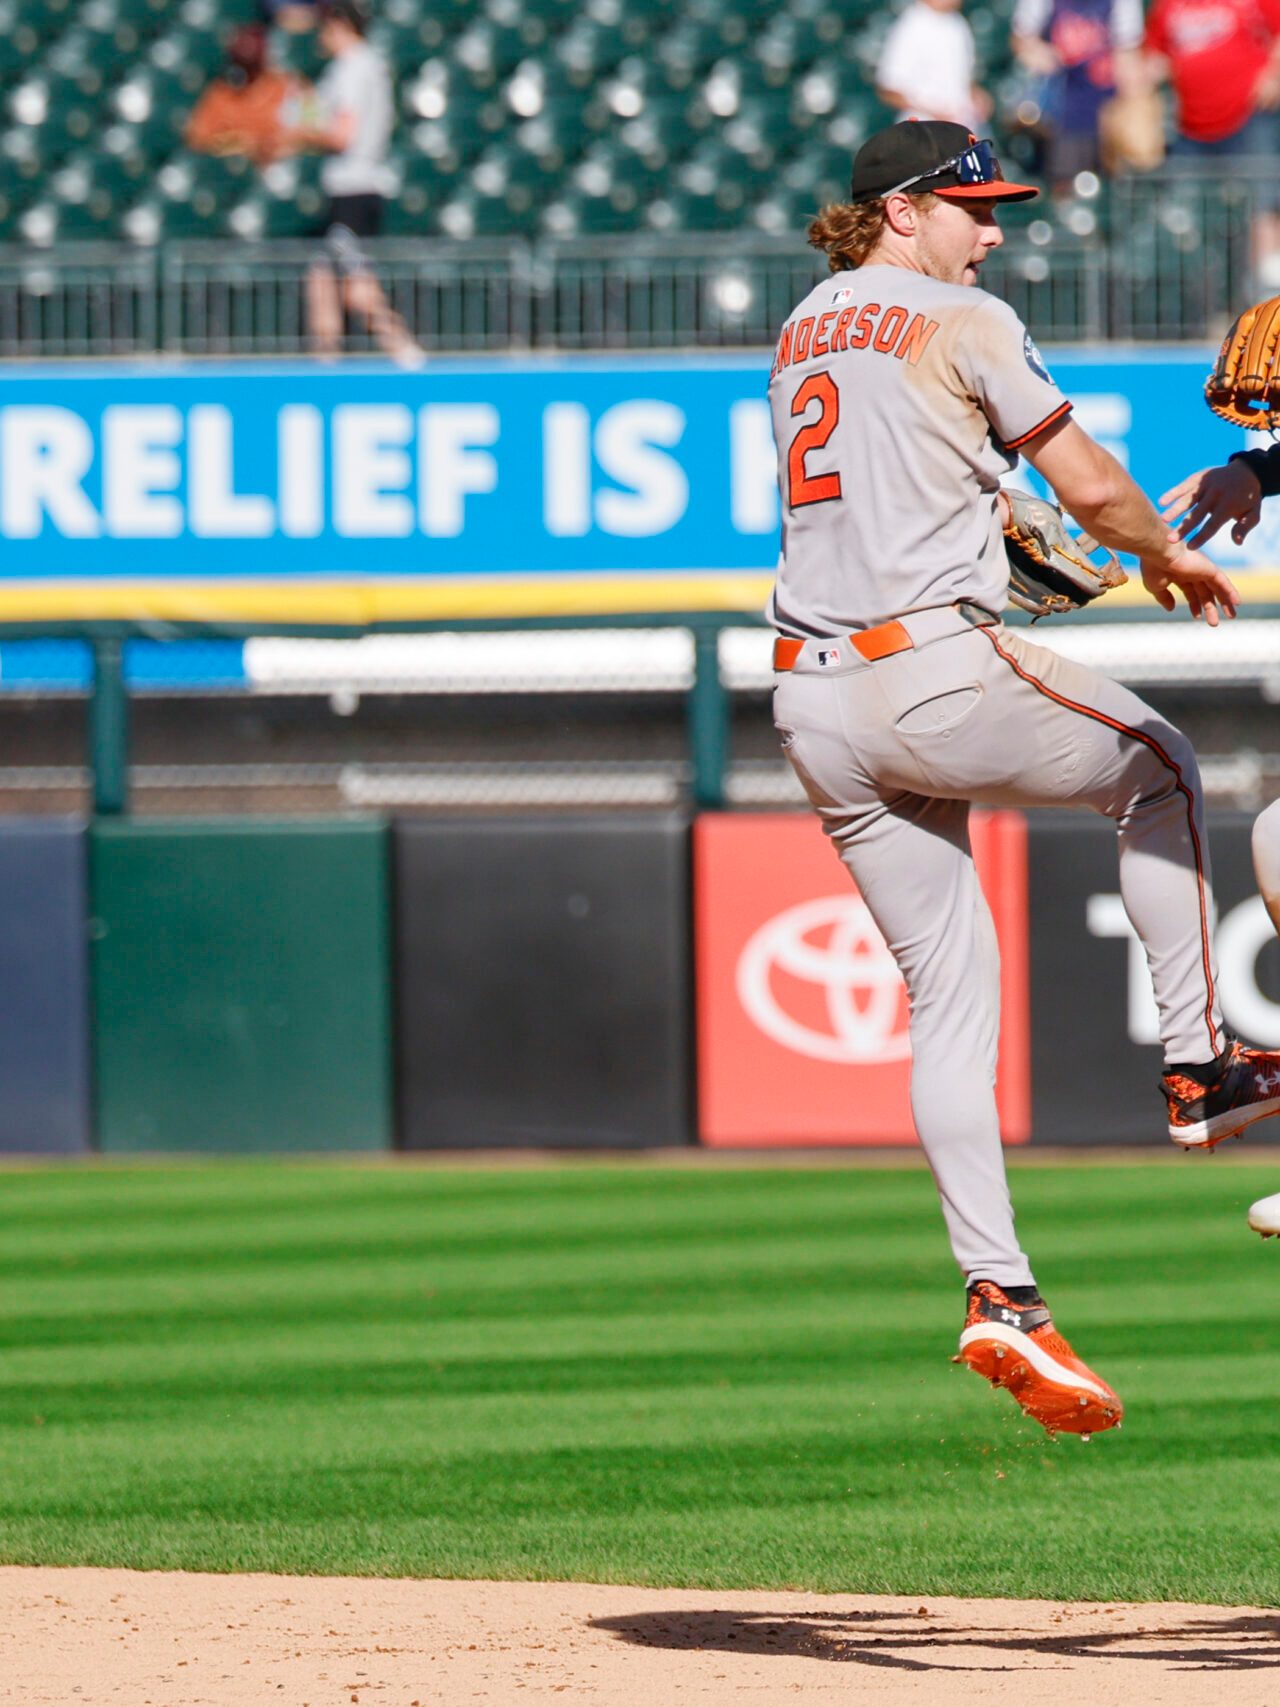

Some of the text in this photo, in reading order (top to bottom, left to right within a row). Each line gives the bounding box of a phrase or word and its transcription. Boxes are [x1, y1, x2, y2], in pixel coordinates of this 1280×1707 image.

[0, 401, 500, 539] RELIEF
[542, 398, 690, 537] IS
[788, 370, 843, 511] 2
